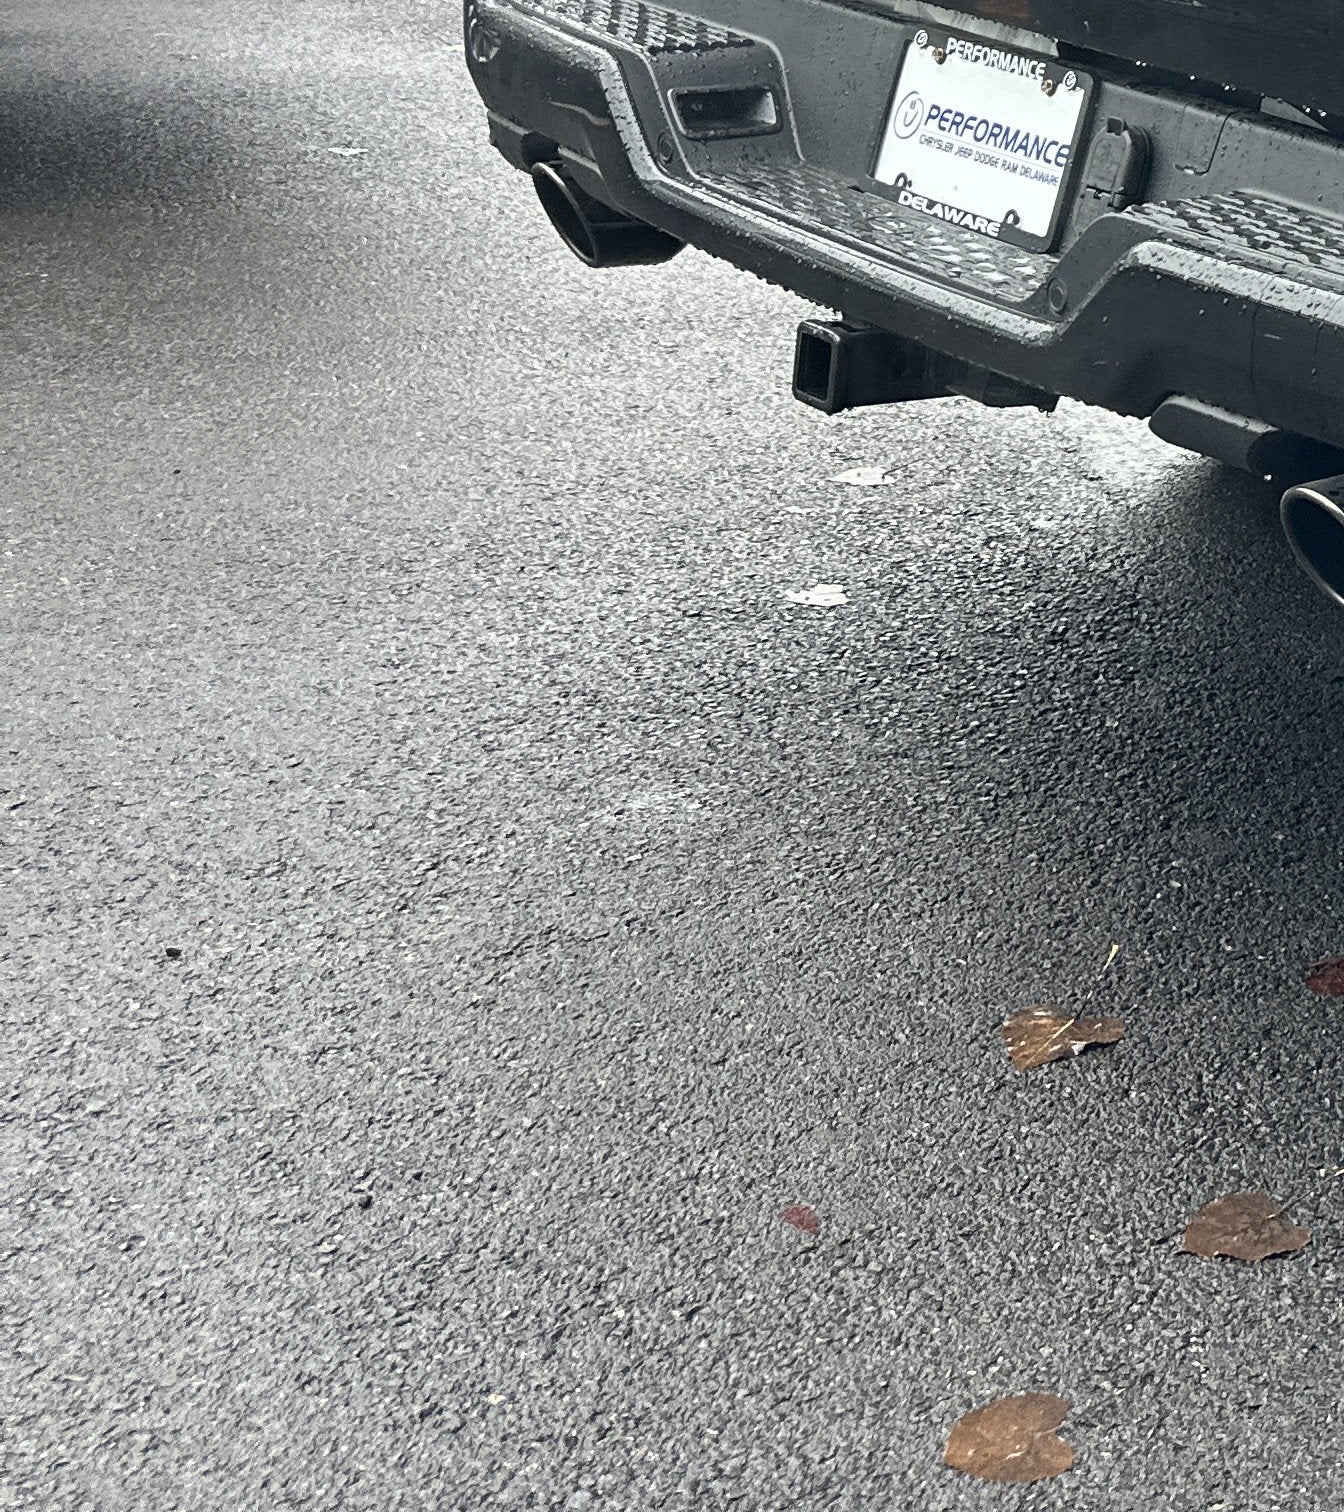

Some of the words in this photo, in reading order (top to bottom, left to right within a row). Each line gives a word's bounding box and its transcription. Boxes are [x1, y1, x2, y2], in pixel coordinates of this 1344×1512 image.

[945, 37, 1046, 80] PERFORMANCE
[919, 133, 954, 153] CHRYSLER
[954, 146, 974, 159] JEEP
[974, 151, 1001, 169] DODGE
[1001, 159, 1018, 175] RAM
[1019, 165, 1060, 187] DELAWARE
[924, 104, 1073, 167] PERFORMANCE
[898, 190, 1001, 237] DELAWARE
